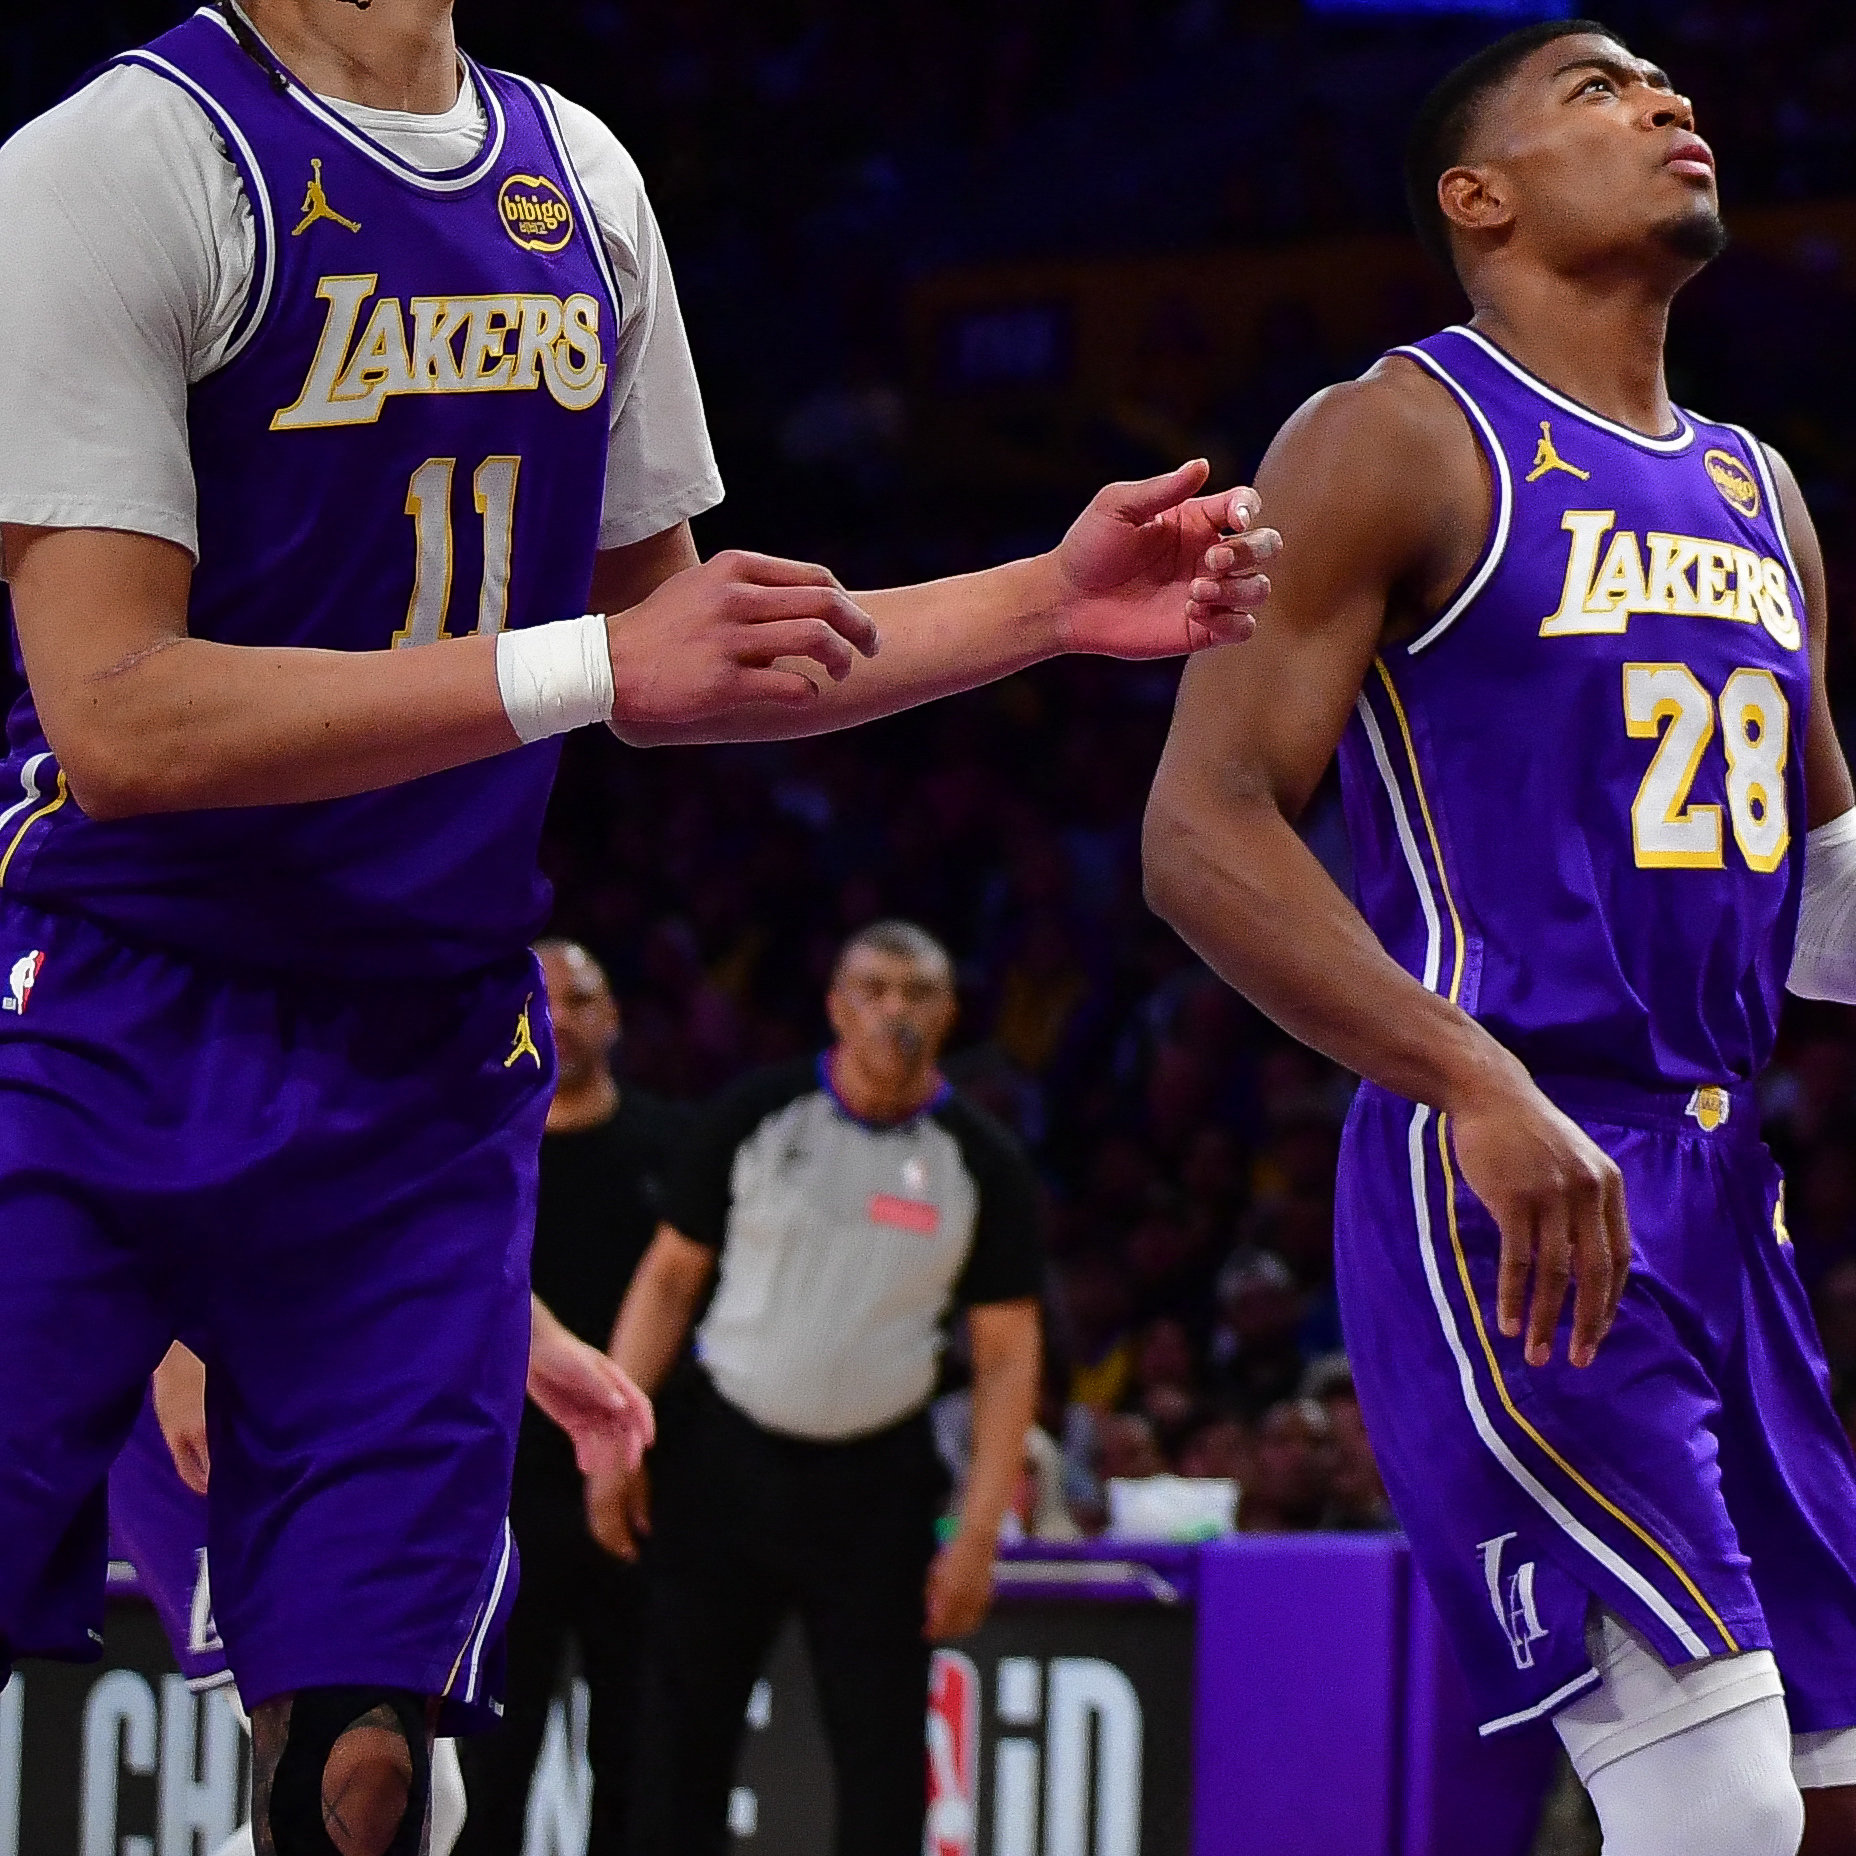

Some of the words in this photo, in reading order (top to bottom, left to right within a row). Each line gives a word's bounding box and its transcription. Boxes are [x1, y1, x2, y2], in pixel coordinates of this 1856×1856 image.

[503, 194, 567, 230] bibigo
[269, 273, 608, 430] LAKERS
[392, 455, 522, 650] 11
[1538, 510, 1802, 651] LAKERS
[1622, 662, 1792, 873] 28
